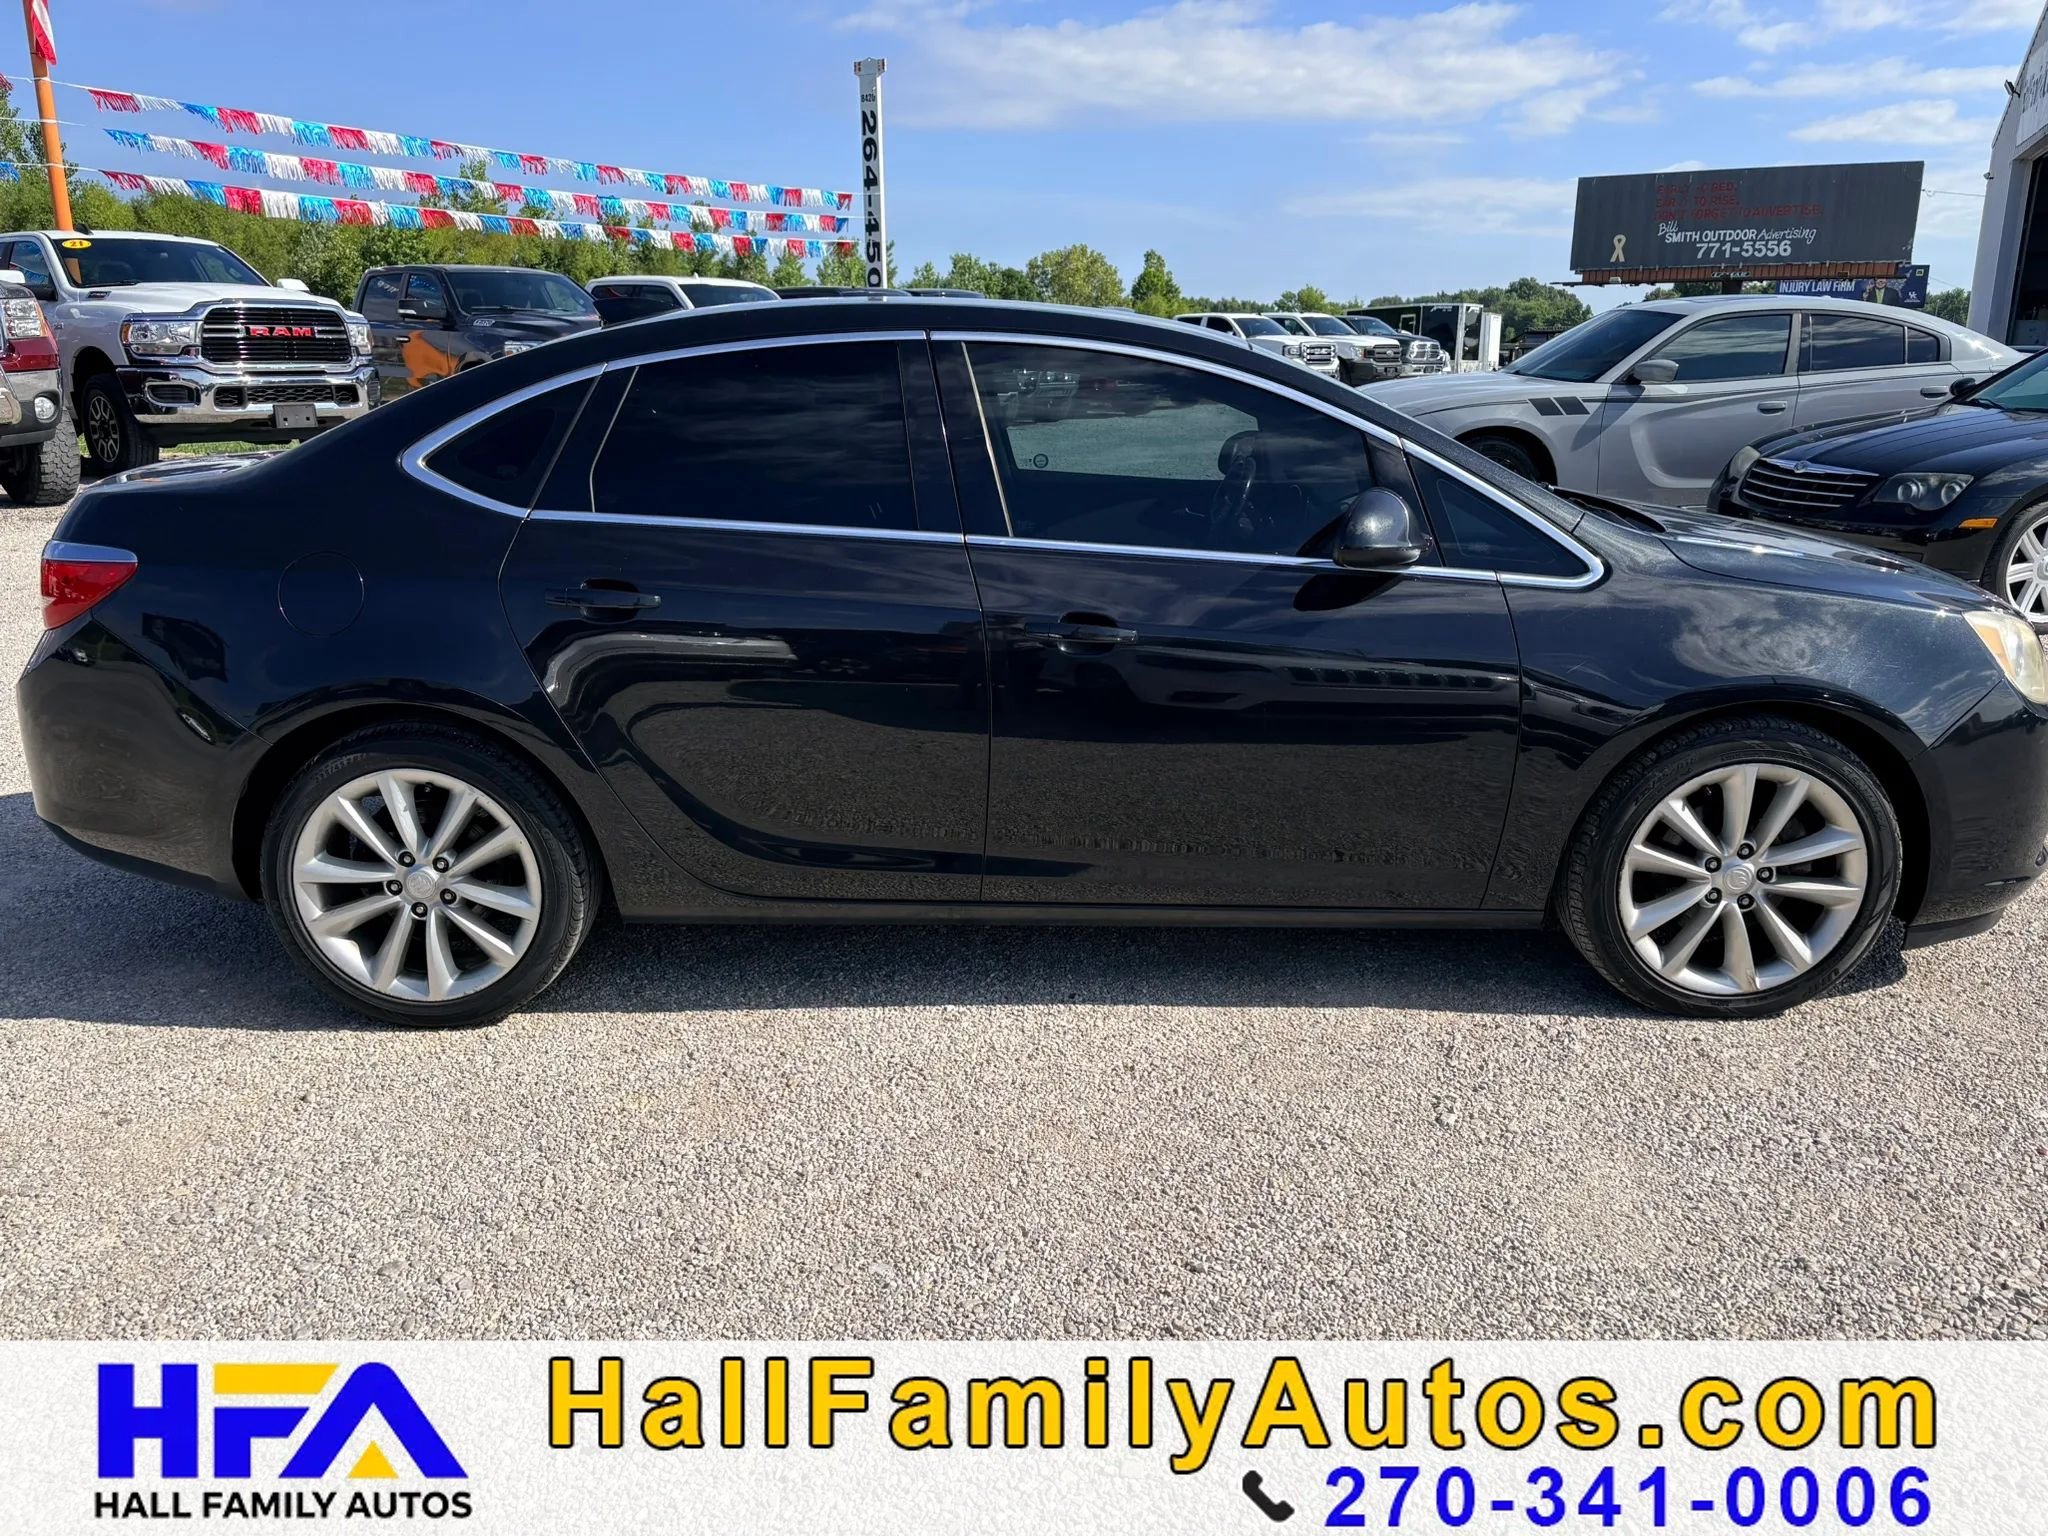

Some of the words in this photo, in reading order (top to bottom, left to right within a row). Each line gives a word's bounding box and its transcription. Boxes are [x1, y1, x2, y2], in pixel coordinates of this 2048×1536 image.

[1657, 221, 1679, 236] Bill
[1665, 230, 1700, 243] SMITH
[1702, 229, 1756, 242] OUTDOOR
[1757, 226, 1817, 244] Advertising
[1696, 240, 1792, 259] 771-5556
[1811, 280, 1832, 292] LAW
[249, 326, 312, 337] RAM
